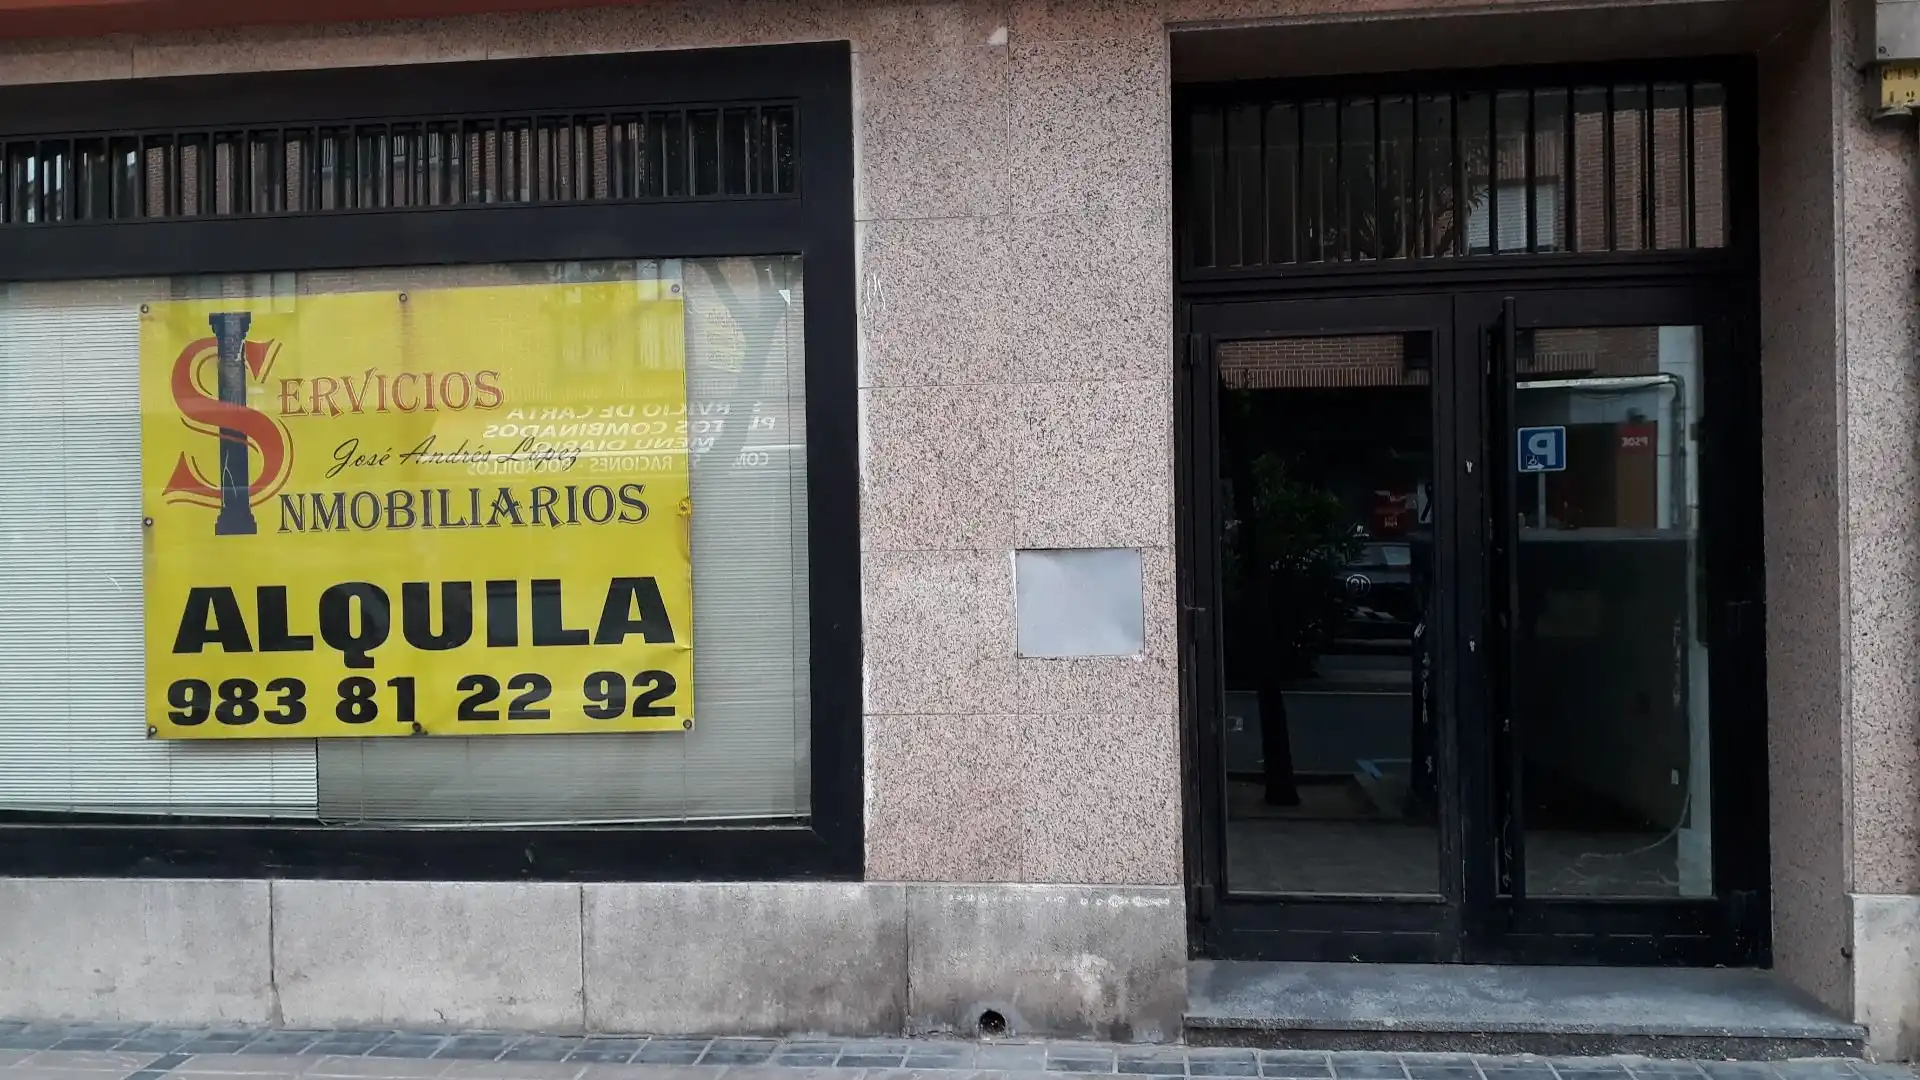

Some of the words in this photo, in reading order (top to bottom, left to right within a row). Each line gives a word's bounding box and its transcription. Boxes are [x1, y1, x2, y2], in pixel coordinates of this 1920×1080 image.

[325, 437, 392, 479] José
[399, 434, 492, 465] Andrés
[171, 576, 676, 669] ALQUILA
[167, 676, 307, 726] 983
[335, 675, 417, 724] 81
[456, 672, 552, 722] 22
[582, 670, 677, 720] 92
